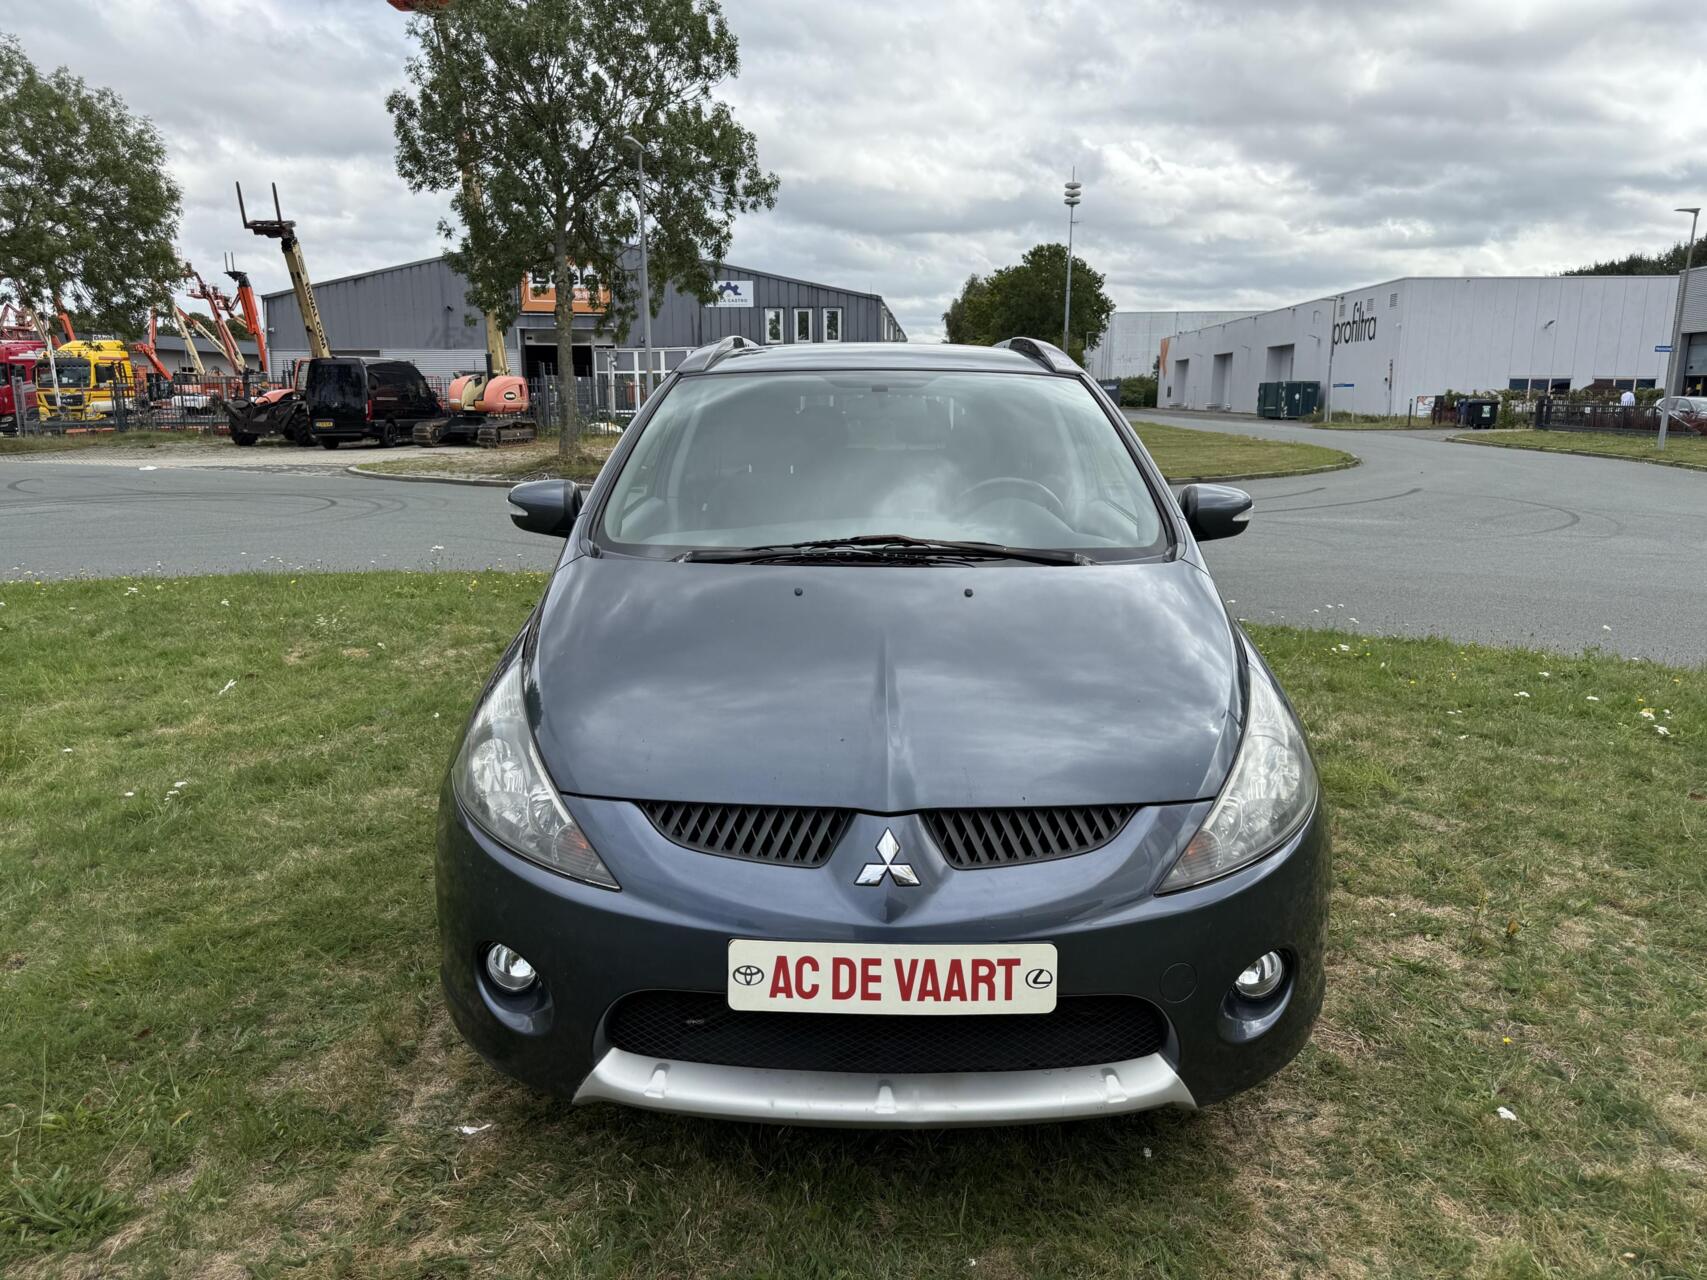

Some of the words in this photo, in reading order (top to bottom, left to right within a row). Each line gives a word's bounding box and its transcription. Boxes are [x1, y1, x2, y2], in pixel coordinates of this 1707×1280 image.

[1333, 301, 1376, 345] profiltra
[769, 955, 820, 1000] AC
[832, 956, 882, 1001] DE
[894, 957, 1022, 1002] VAART
